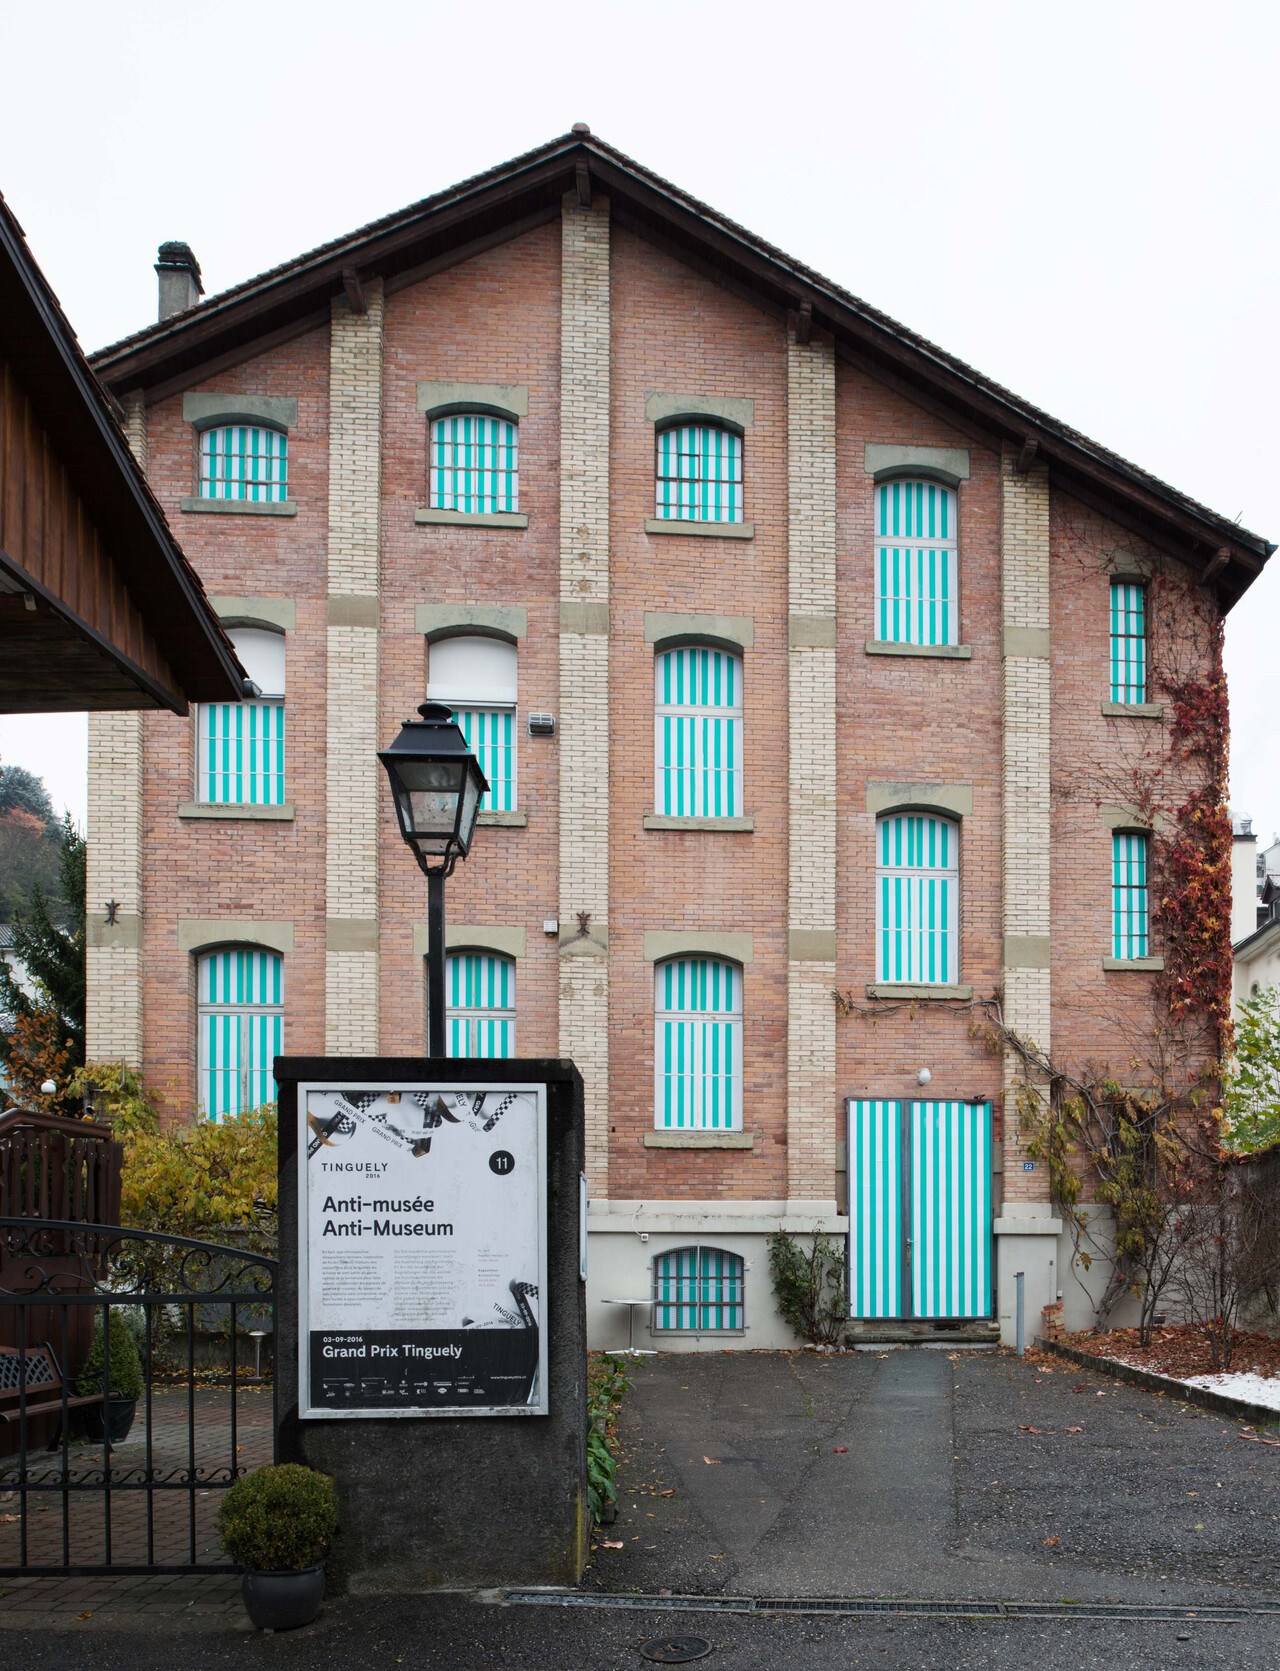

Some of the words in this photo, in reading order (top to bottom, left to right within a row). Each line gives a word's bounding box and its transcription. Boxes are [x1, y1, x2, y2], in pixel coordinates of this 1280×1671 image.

[333, 1099, 353, 1115] GRAND
[353, 1113, 367, 1124] PRIX
[371, 1126, 391, 1142] GRAND
[390, 1139, 403, 1149] PRIX
[321, 1163, 389, 1172] TINGUELY
[496, 1157, 508, 1170] 11
[322, 1195, 435, 1213] Anti-musée
[322, 1219, 454, 1237] Anti-Museum
[492, 1302, 522, 1327] TINGUELY
[322, 1345, 367, 1358] Grand
[370, 1344, 399, 1357] Prix
[402, 1343, 463, 1360] Tinguely
